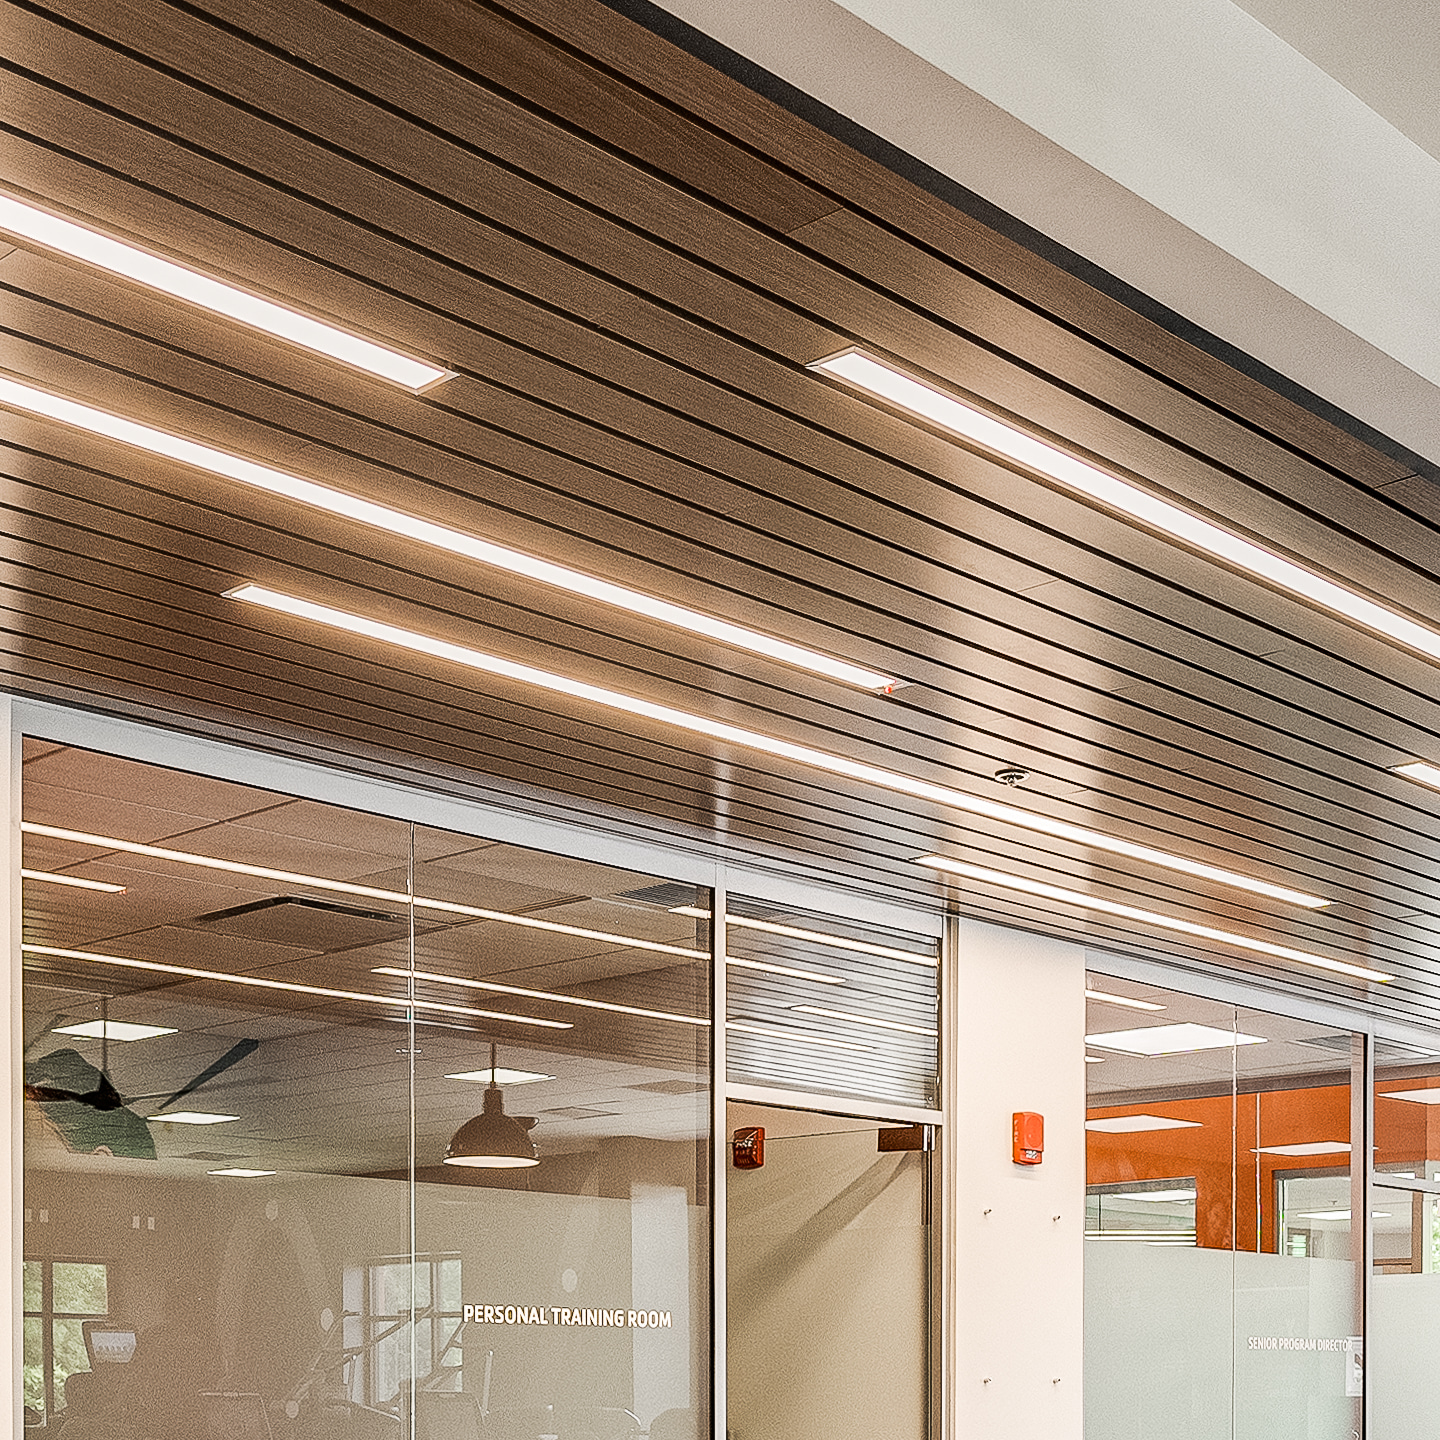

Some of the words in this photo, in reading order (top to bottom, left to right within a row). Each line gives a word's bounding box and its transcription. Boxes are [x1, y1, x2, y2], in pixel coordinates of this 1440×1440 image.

[463, 1304, 549, 1325] PERSONAL
[551, 1307, 625, 1327] TRAINING
[627, 1309, 672, 1329] ROOM
[1247, 1336, 1278, 1350] SENIOR
[1278, 1337, 1317, 1351] PROGRAM
[1317, 1338, 1353, 1352] DIRECTOR
